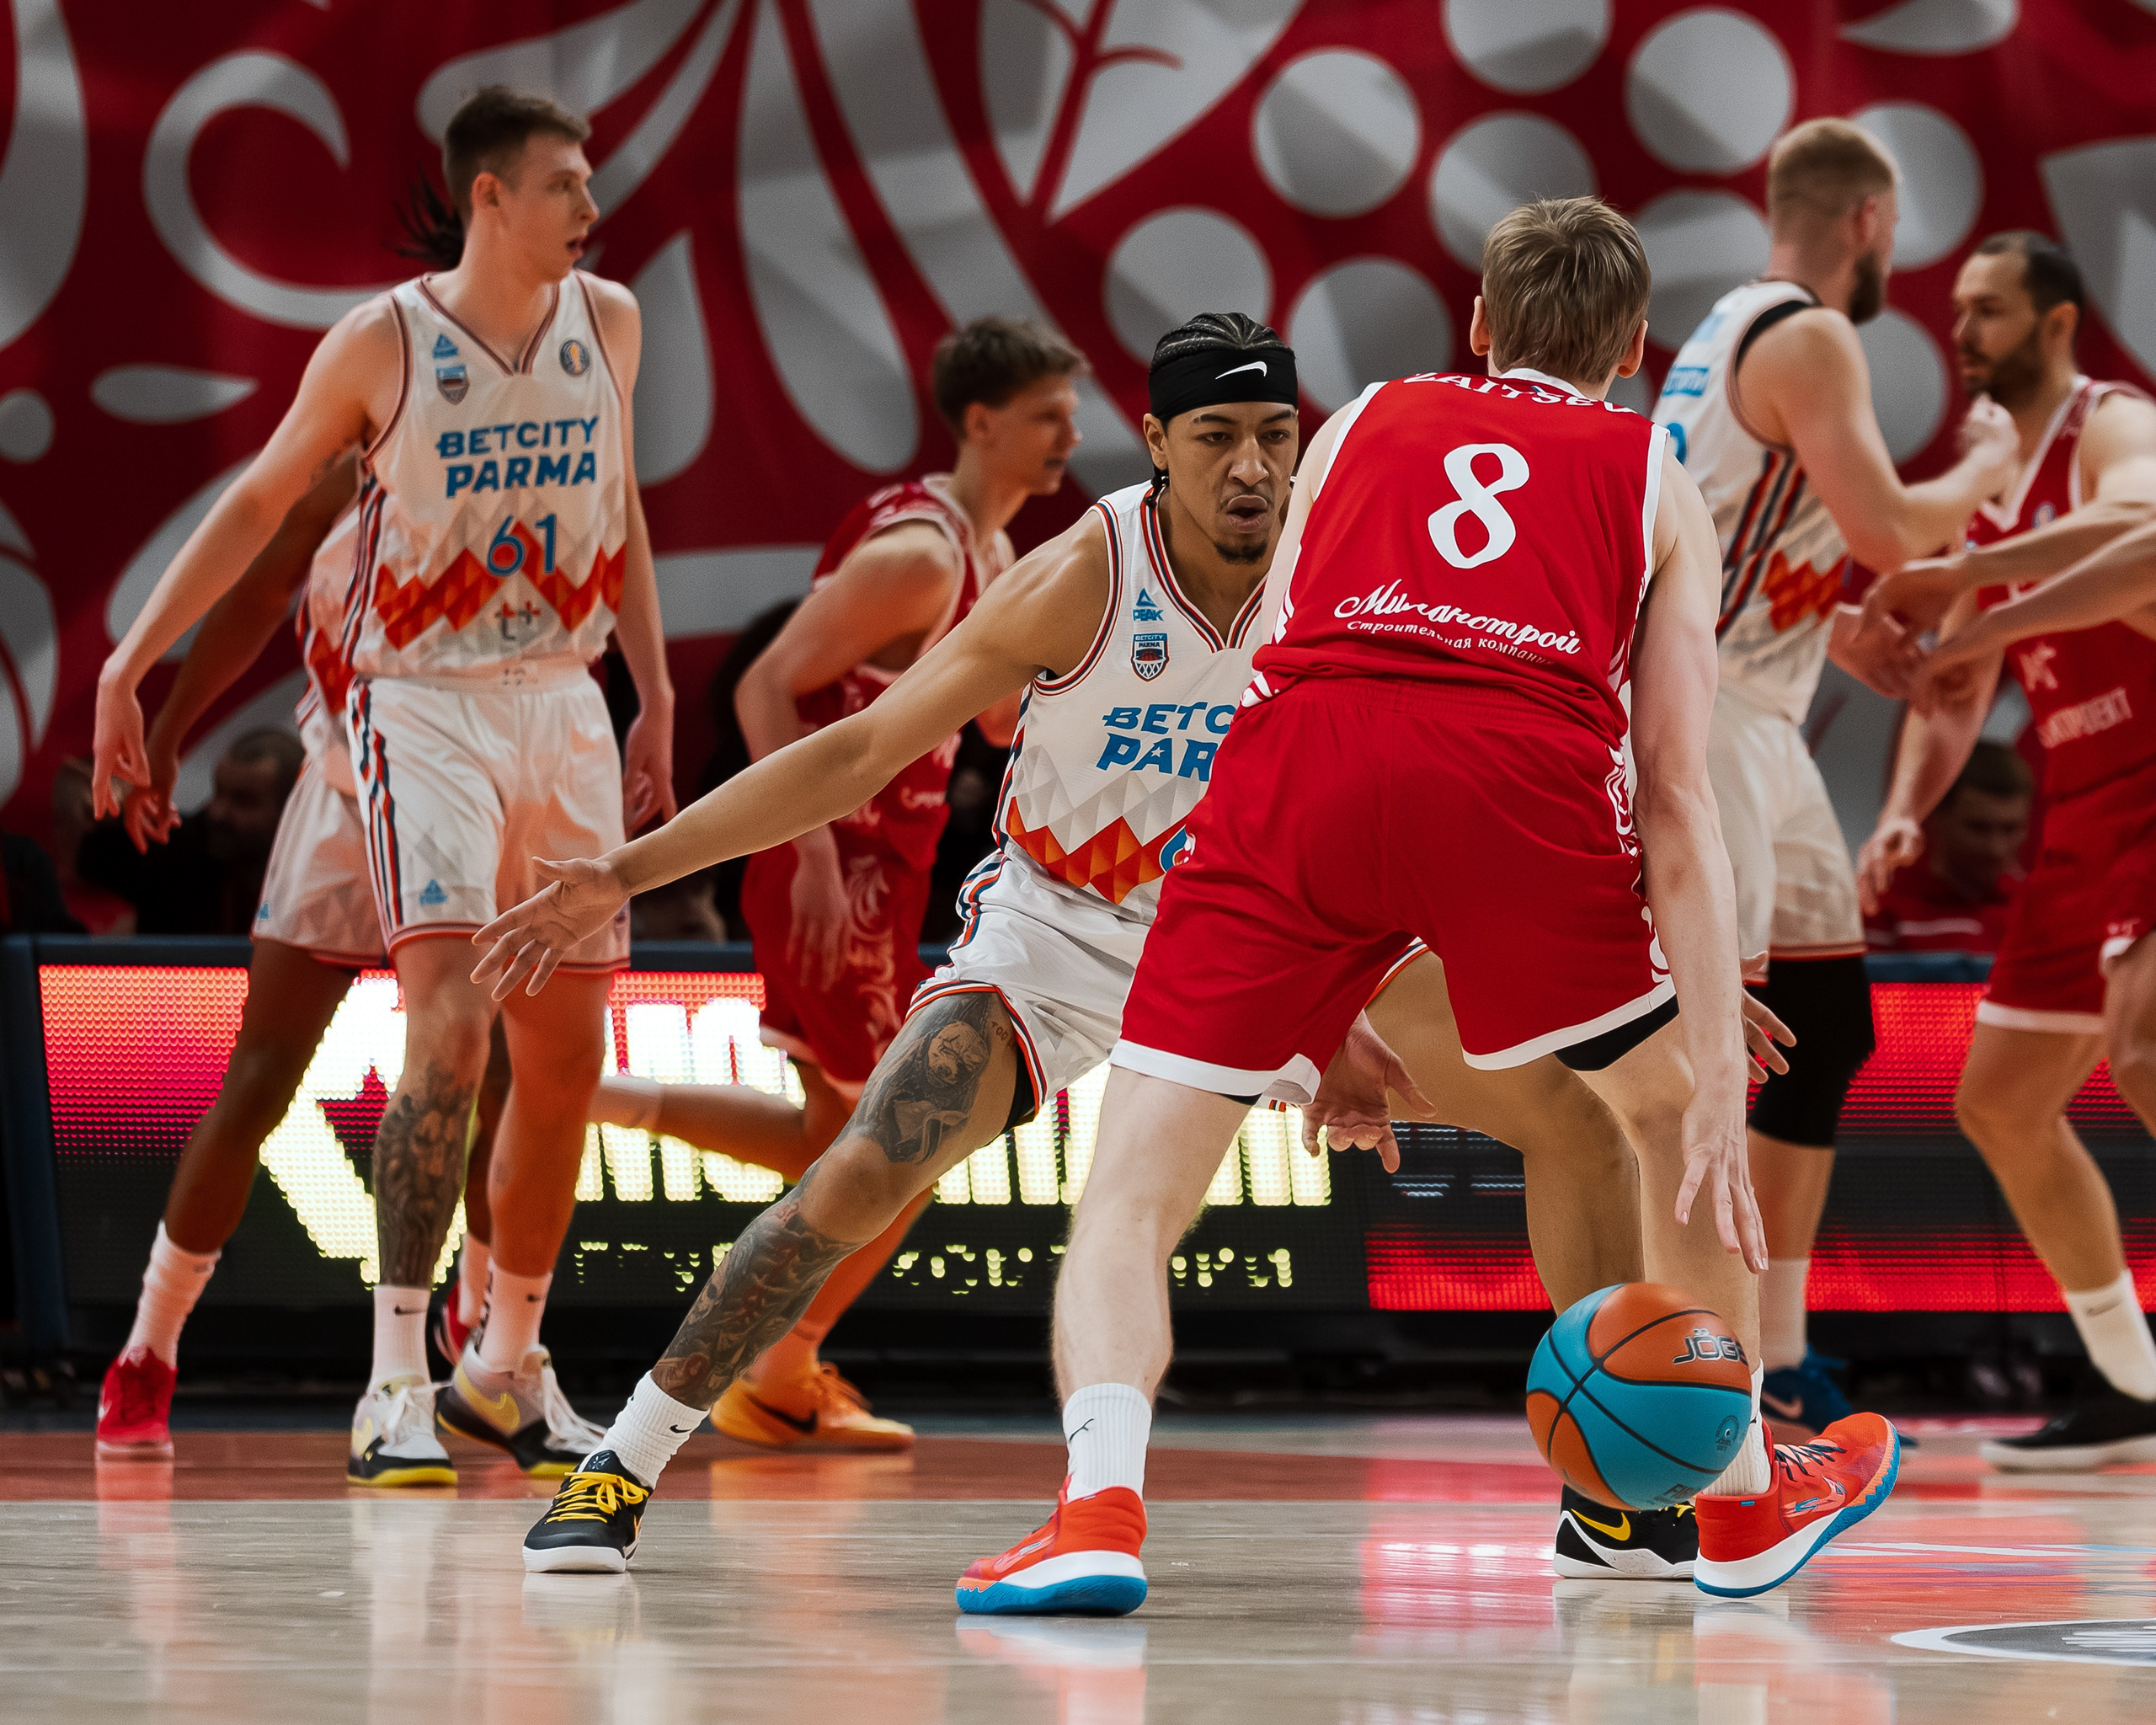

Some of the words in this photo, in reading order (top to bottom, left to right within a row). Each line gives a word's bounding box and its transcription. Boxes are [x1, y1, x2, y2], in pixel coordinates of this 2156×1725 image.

[435, 416, 599, 459] BETCITY
[446, 451, 596, 499] PARMA
[1428, 443, 1529, 569] 8
[487, 513, 557, 577] 61
[1133, 609, 1164, 622] PEAK
[1478, 638, 1555, 665] компани
[1102, 702, 1237, 734] BETC
[1096, 732, 1219, 782] PAR
